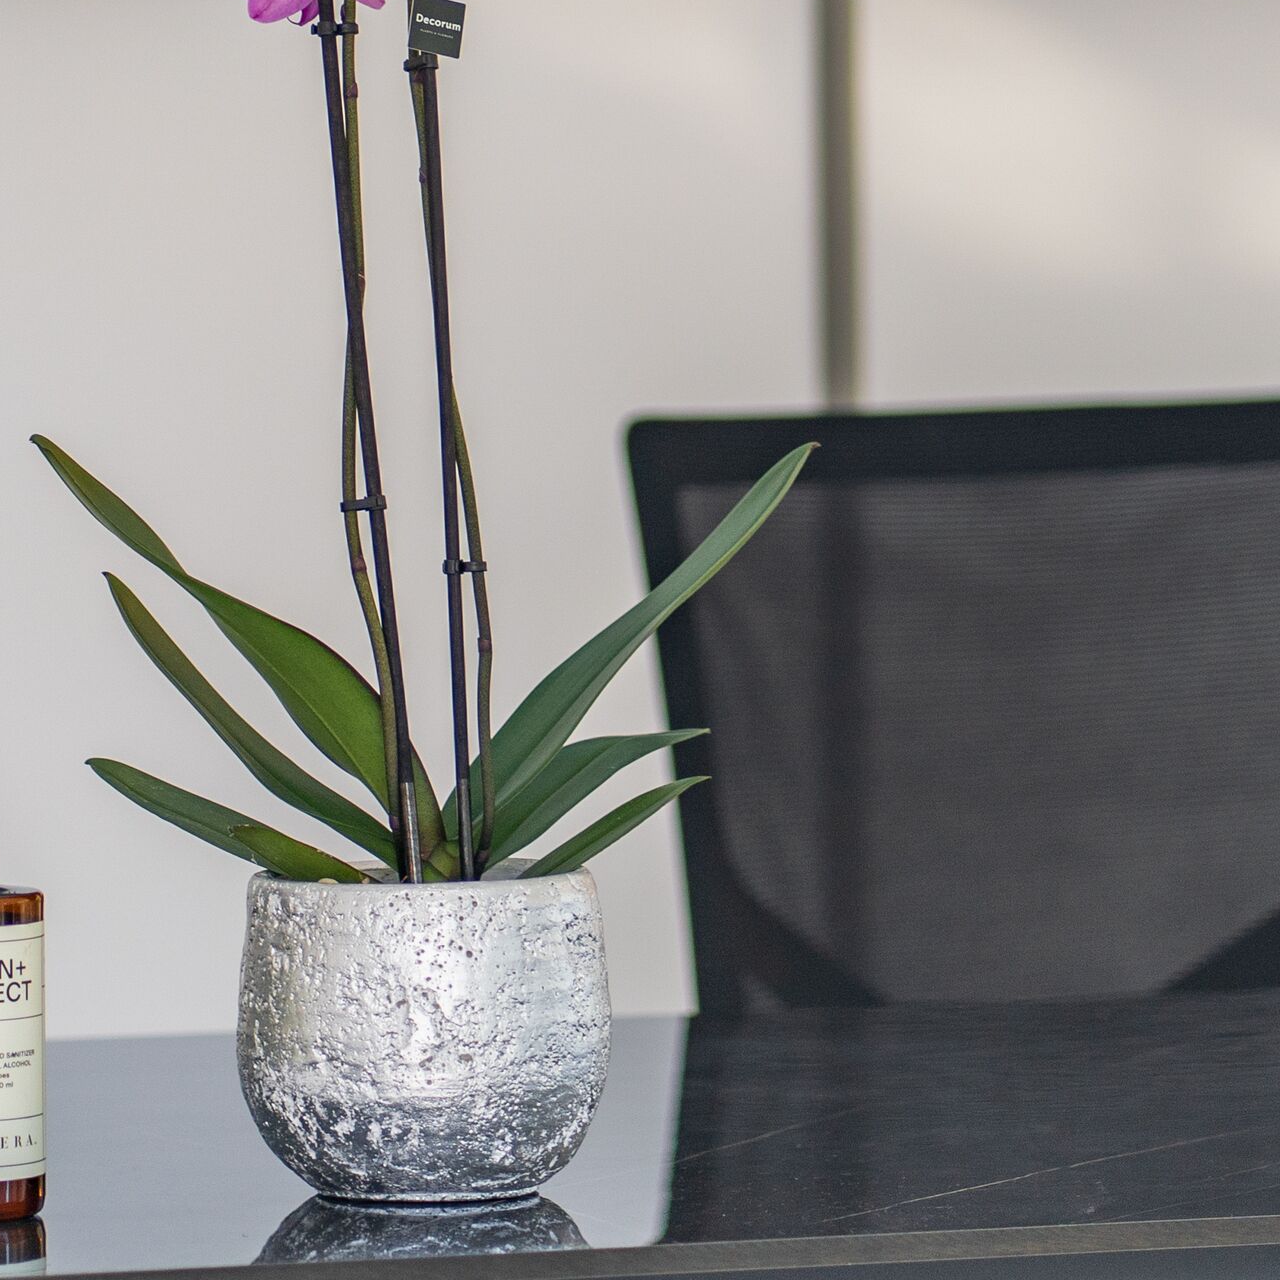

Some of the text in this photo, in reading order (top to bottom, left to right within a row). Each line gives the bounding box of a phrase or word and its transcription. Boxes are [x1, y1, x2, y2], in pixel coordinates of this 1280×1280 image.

[415, 13, 461, 32] Decorum
[6, 1049, 35, 1059] SANITIZER
[3, 1060, 31, 1069] ALCOHOL
[5, 1080, 14, 1088] ml
